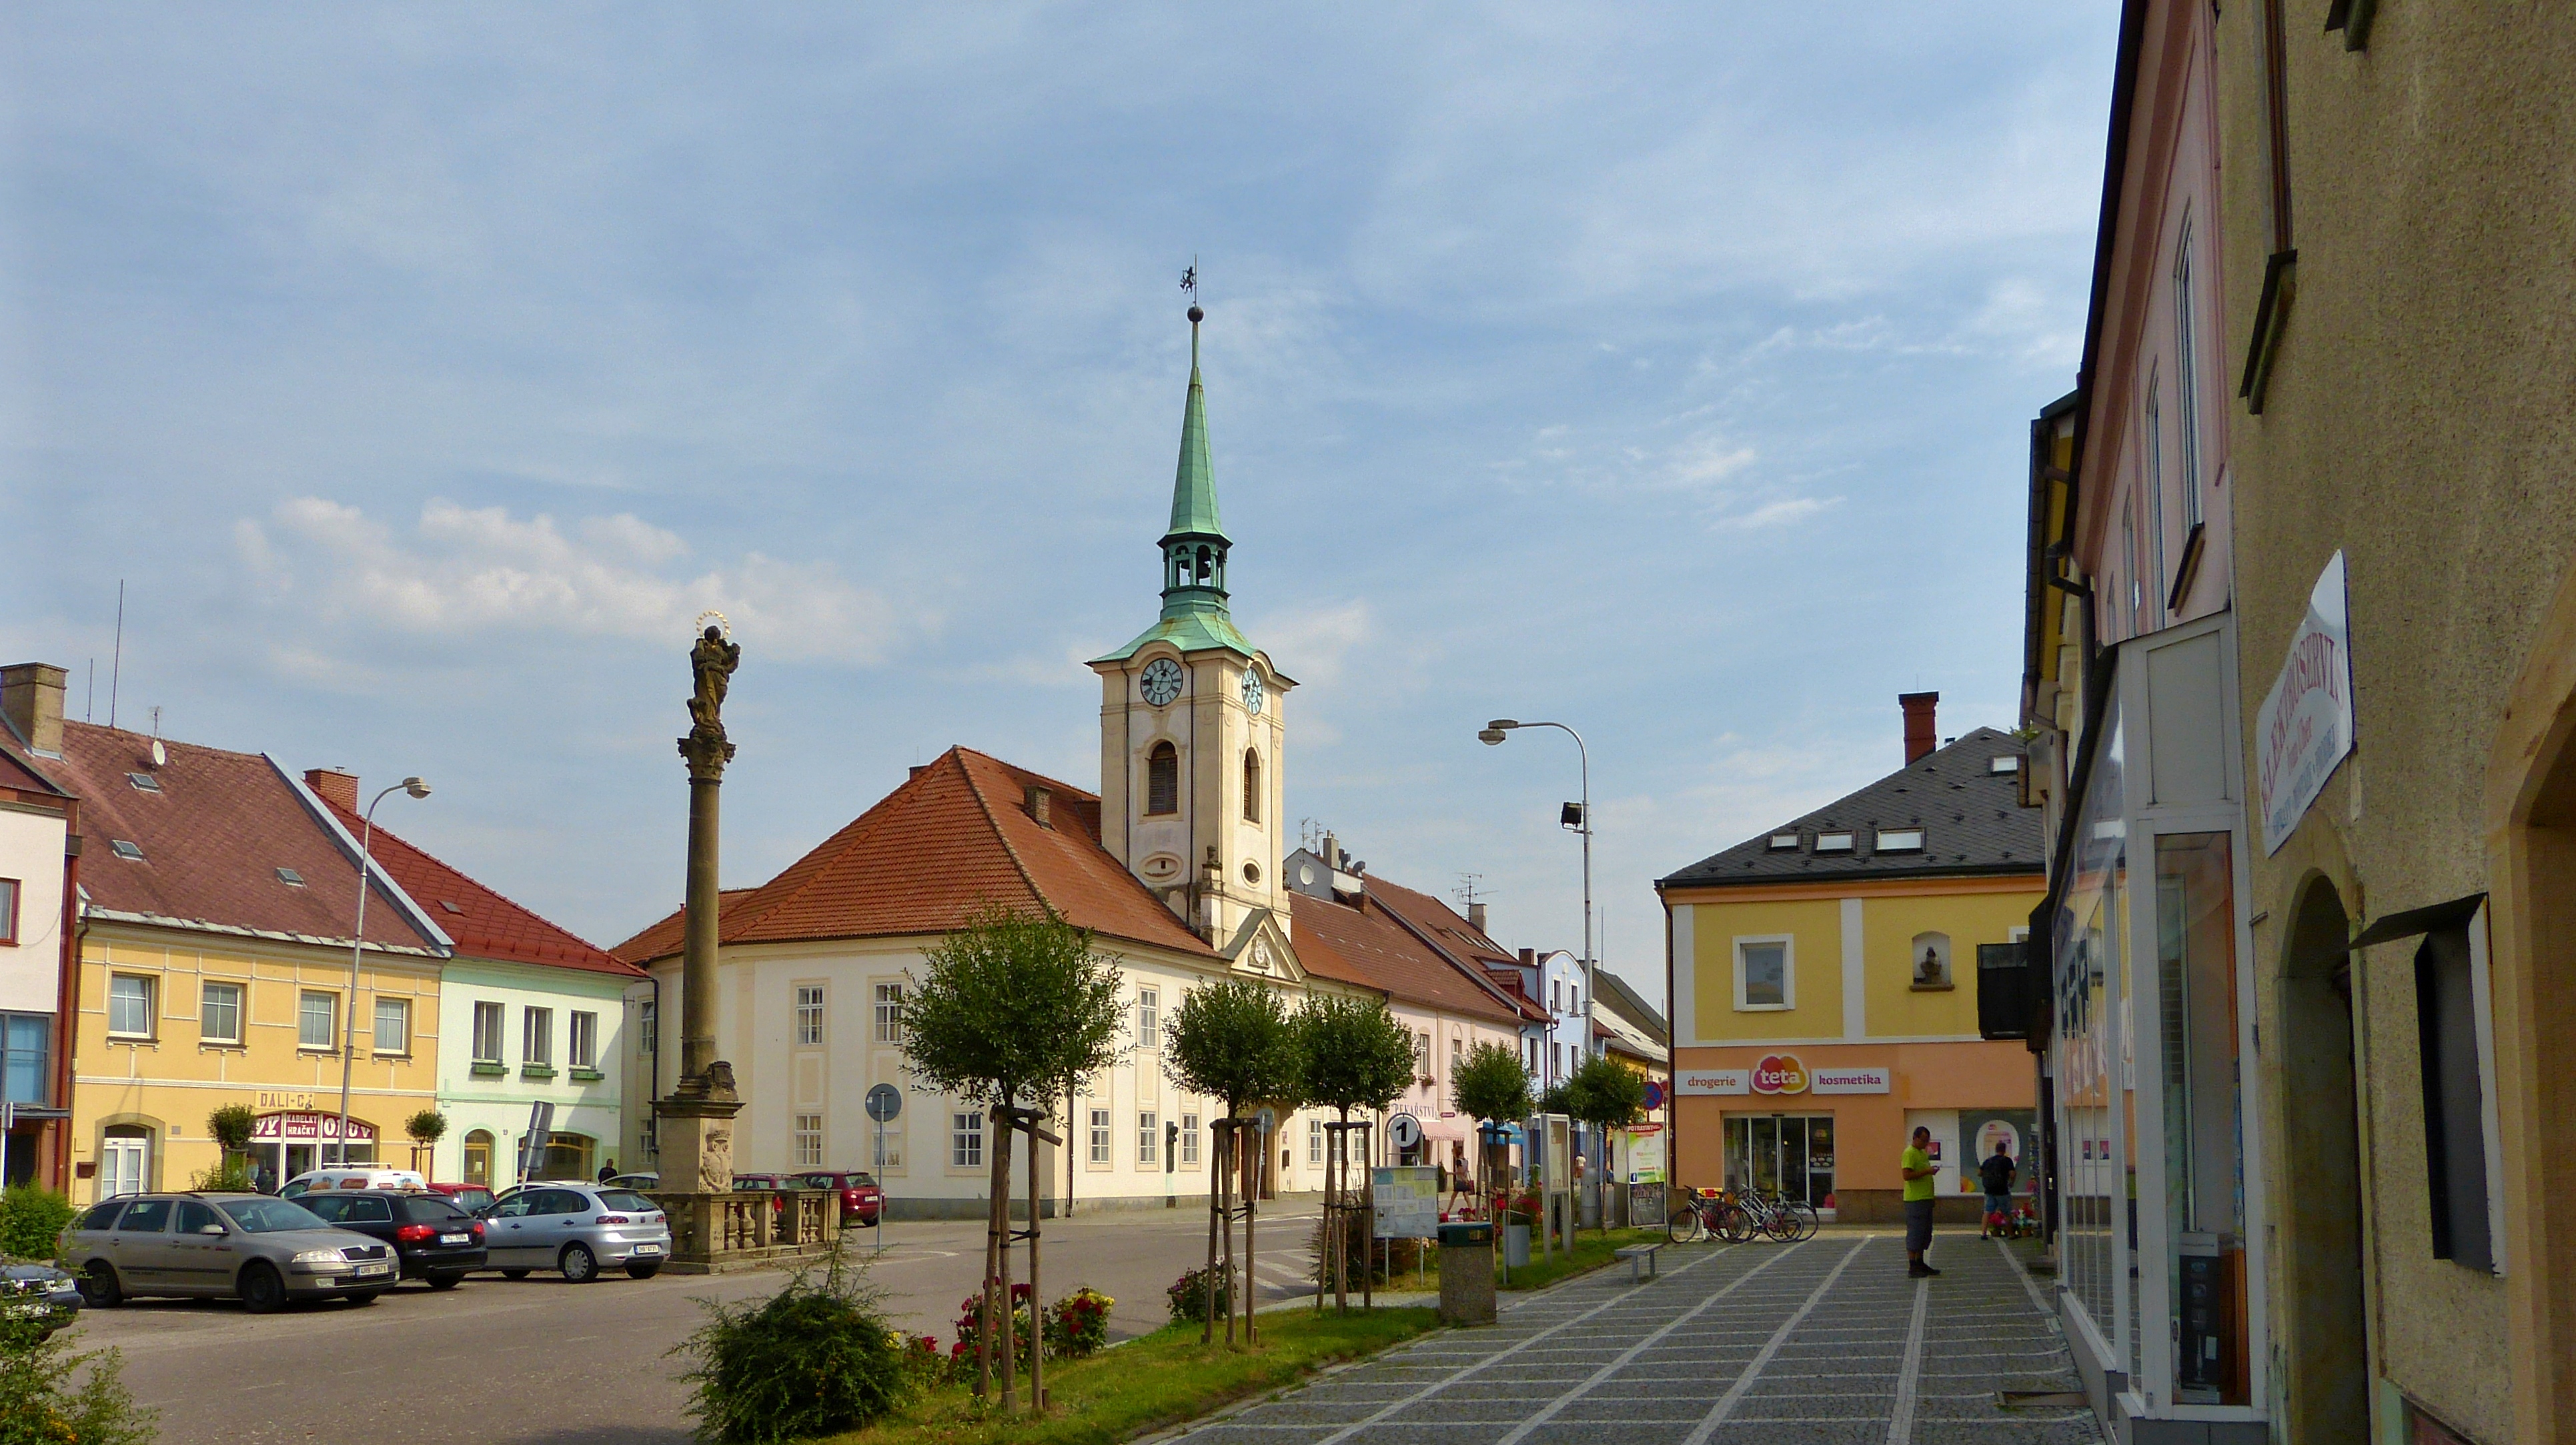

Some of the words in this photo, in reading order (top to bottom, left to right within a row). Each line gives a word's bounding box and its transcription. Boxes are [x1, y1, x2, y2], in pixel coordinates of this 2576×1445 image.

[1688, 1076, 1736, 1088] drogerie
[1760, 1069, 1800, 1084] teta
[1819, 1074, 1882, 1085] kosmetika
[287, 1124, 315, 1135] HRAČKY
[1395, 1122, 1407, 1142] 1
